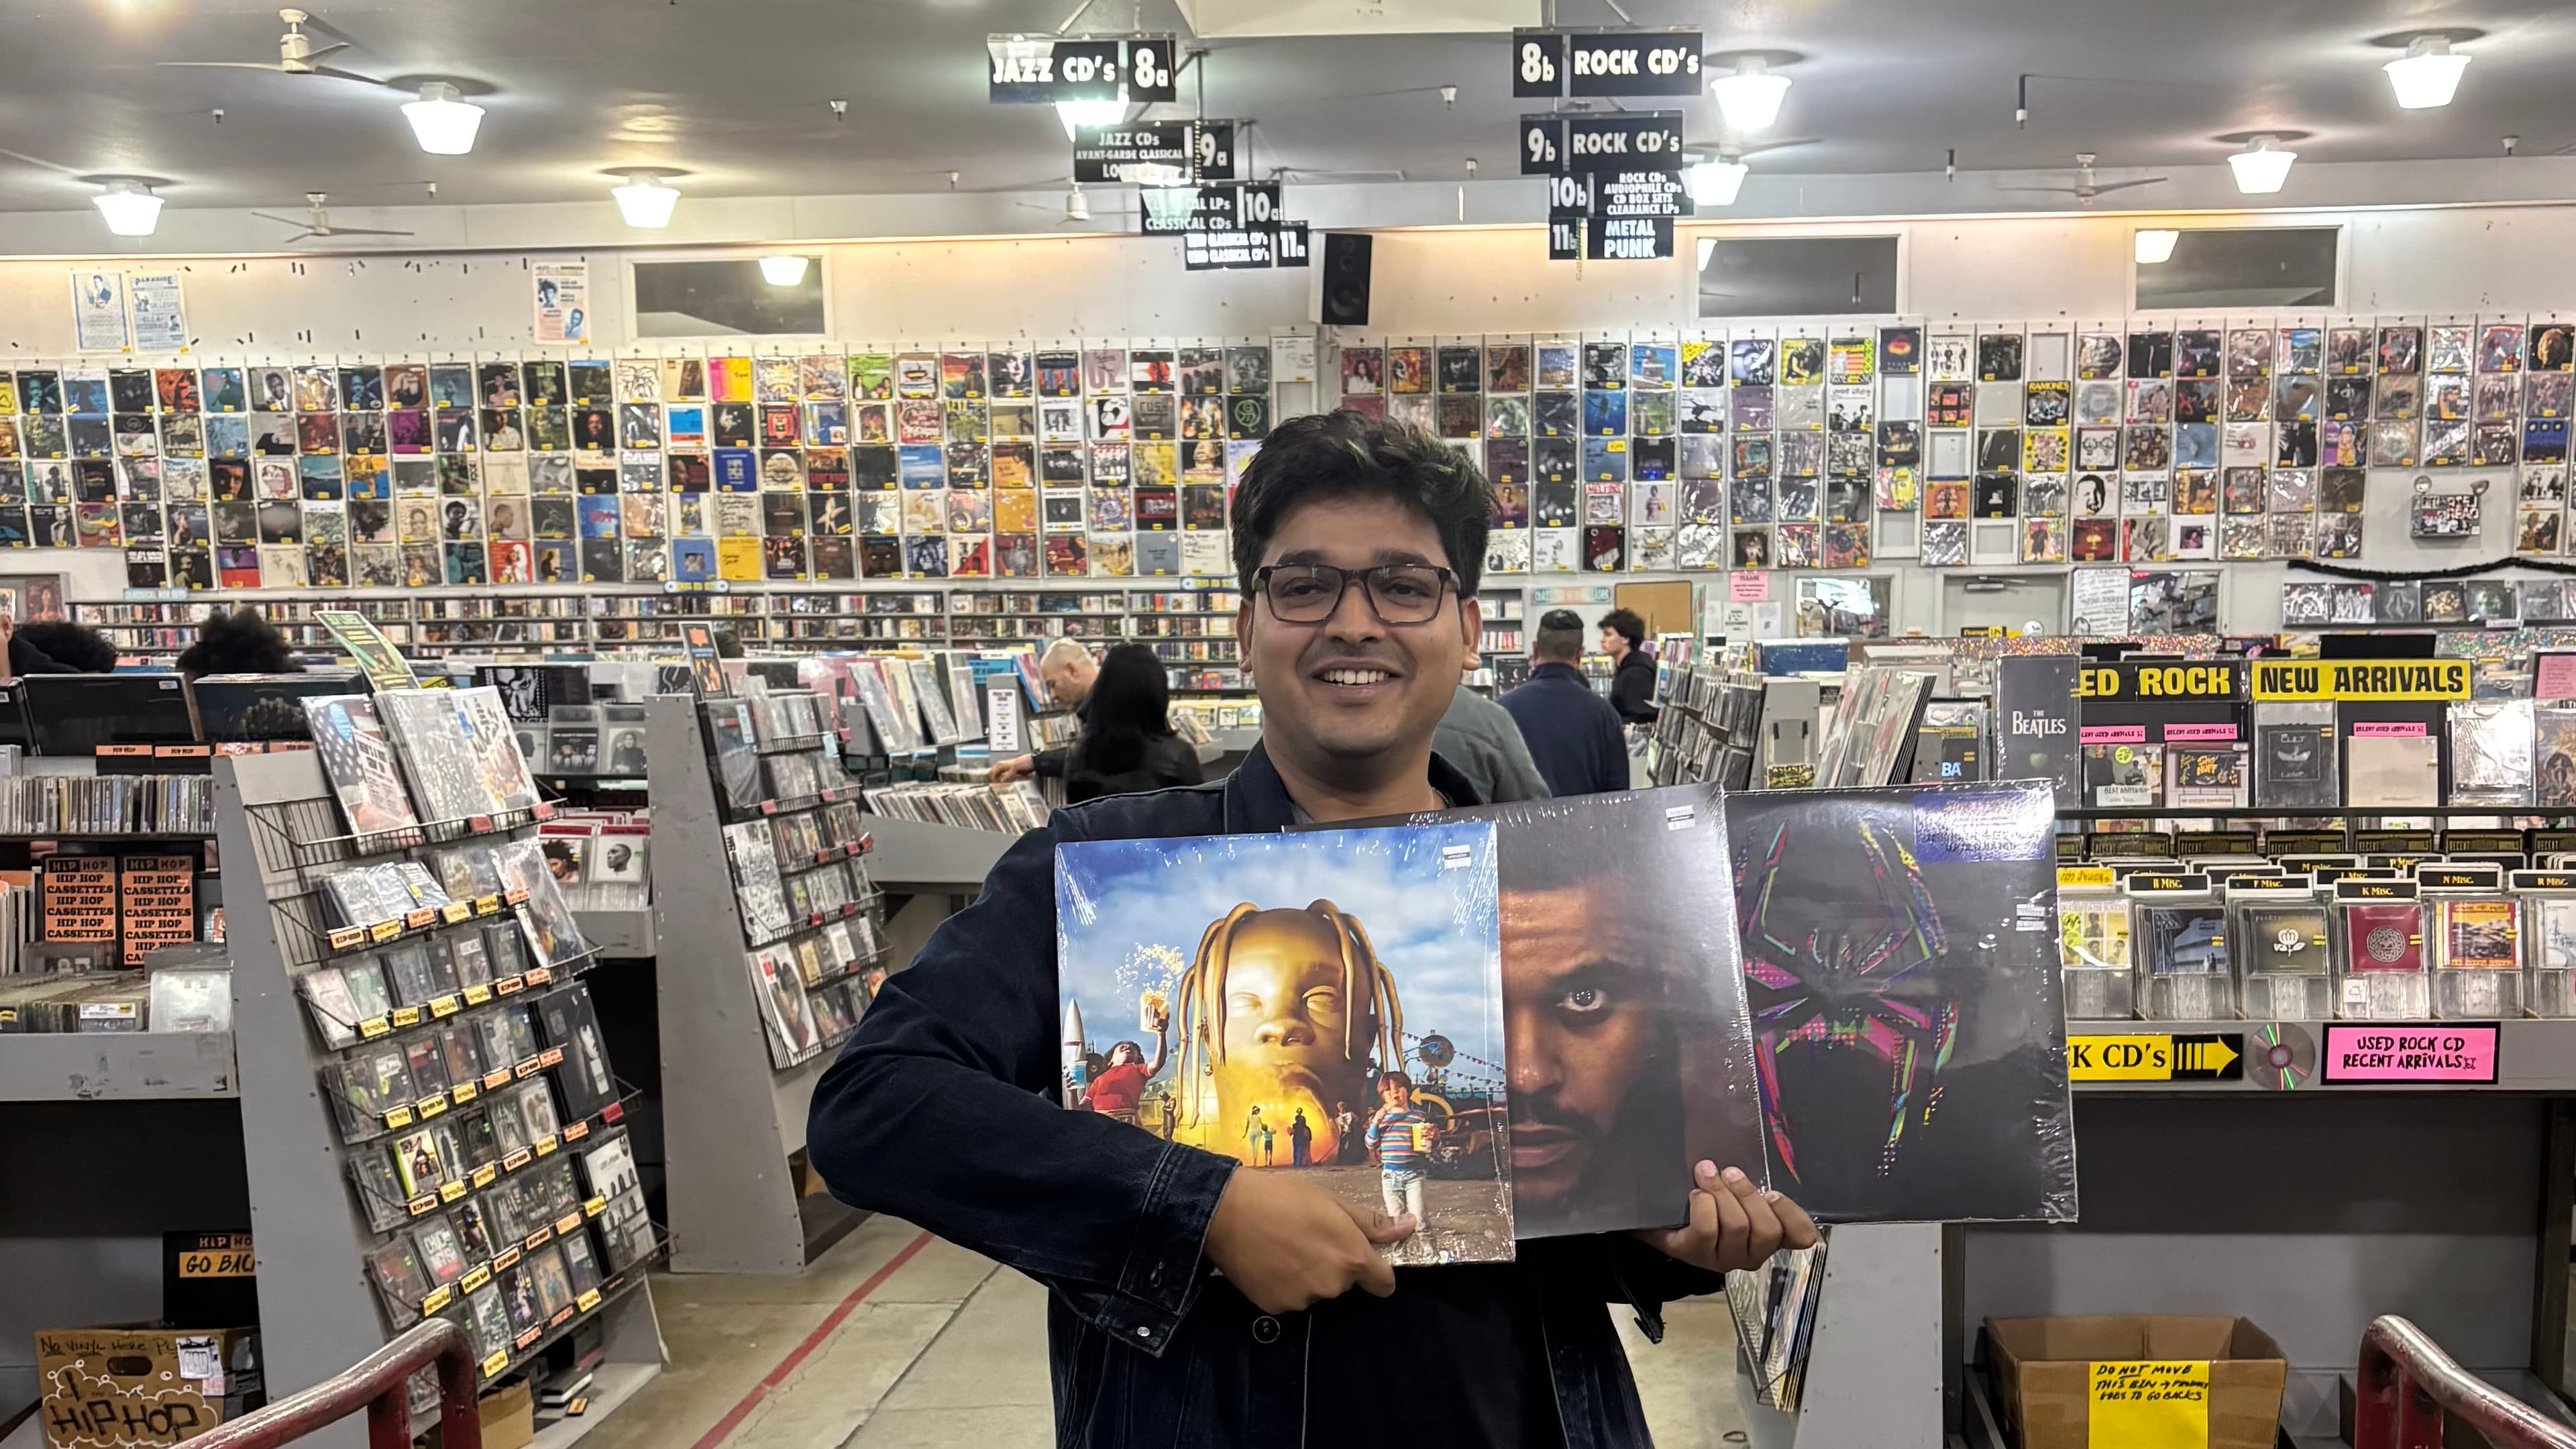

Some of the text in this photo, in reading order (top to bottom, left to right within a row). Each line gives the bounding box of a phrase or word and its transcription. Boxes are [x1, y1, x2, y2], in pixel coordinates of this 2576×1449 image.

[1135, 48, 1169, 87] 8a
[1521, 42, 1555, 83] 8b
[1574, 48, 1699, 75] ROCK CD's
[993, 55, 1116, 83] JAZZ CD's
[1098, 132, 1160, 146] JAZZ CDs
[1527, 128, 1556, 162] 9b
[1573, 130, 1680, 154] ROCK CD's
[1076, 149, 1184, 160] AVANT-GARDE CLASSICAL
[1200, 133, 1228, 167] 9a
[1619, 173, 1646, 183] ROCK
[1550, 176, 1587, 207] 10b
[1604, 182, 1662, 195] AUDIOPHILE
[1210, 197, 1231, 210] LPs
[1613, 193, 1673, 204] CD BOX SETS
[1245, 192, 1281, 222] 10a
[1607, 204, 1660, 215] CLEARANCE
[1605, 220, 1656, 237] METAL
[1279, 231, 1306, 258] 11a
[1604, 238, 1656, 258] PUNK
[2081, 667, 2231, 697] ED ROCK
[2260, 665, 2463, 694] NEW ARRIVALS
[2012, 710, 2067, 739] BEATLES
[83, 859, 108, 871] HOP
[160, 859, 187, 870] HOP
[56, 874, 104, 883] HIP HOP
[133, 875, 181, 884] HIP HOP
[2443, 875, 2451, 884] N
[46, 885, 114, 894] CASSETTES
[123, 886, 191, 896] CASSETTES
[2361, 886, 2369, 896] K
[56, 896, 104, 906] HIP HOP
[133, 897, 182, 906] HIP HOP
[46, 908, 114, 916] CASSETTES
[125, 908, 192, 918] CASSETTES
[56, 918, 105, 927] HIP HOP
[134, 919, 182, 928] HIP HOP
[47, 929, 114, 938] CASSETTES
[125, 930, 193, 939] CASSETTES
[135, 942, 156, 951] HIP
[2357, 1036, 2465, 1053] USED ROCK CD
[2102, 1042, 2166, 1068] CD's
[2343, 1053, 2463, 1069] RECENT ARRIVALS
[199, 1236, 253, 1248] HIP HO
[186, 1256, 211, 1274] GO
[2097, 1364, 2193, 1375] DO NOT MOVE
[2096, 1379, 2125, 1391] THIS
[2129, 1379, 2157, 1389] BIN
[2147, 1391, 2161, 1401] GO
[50, 1399, 201, 1442] HIP HOP
